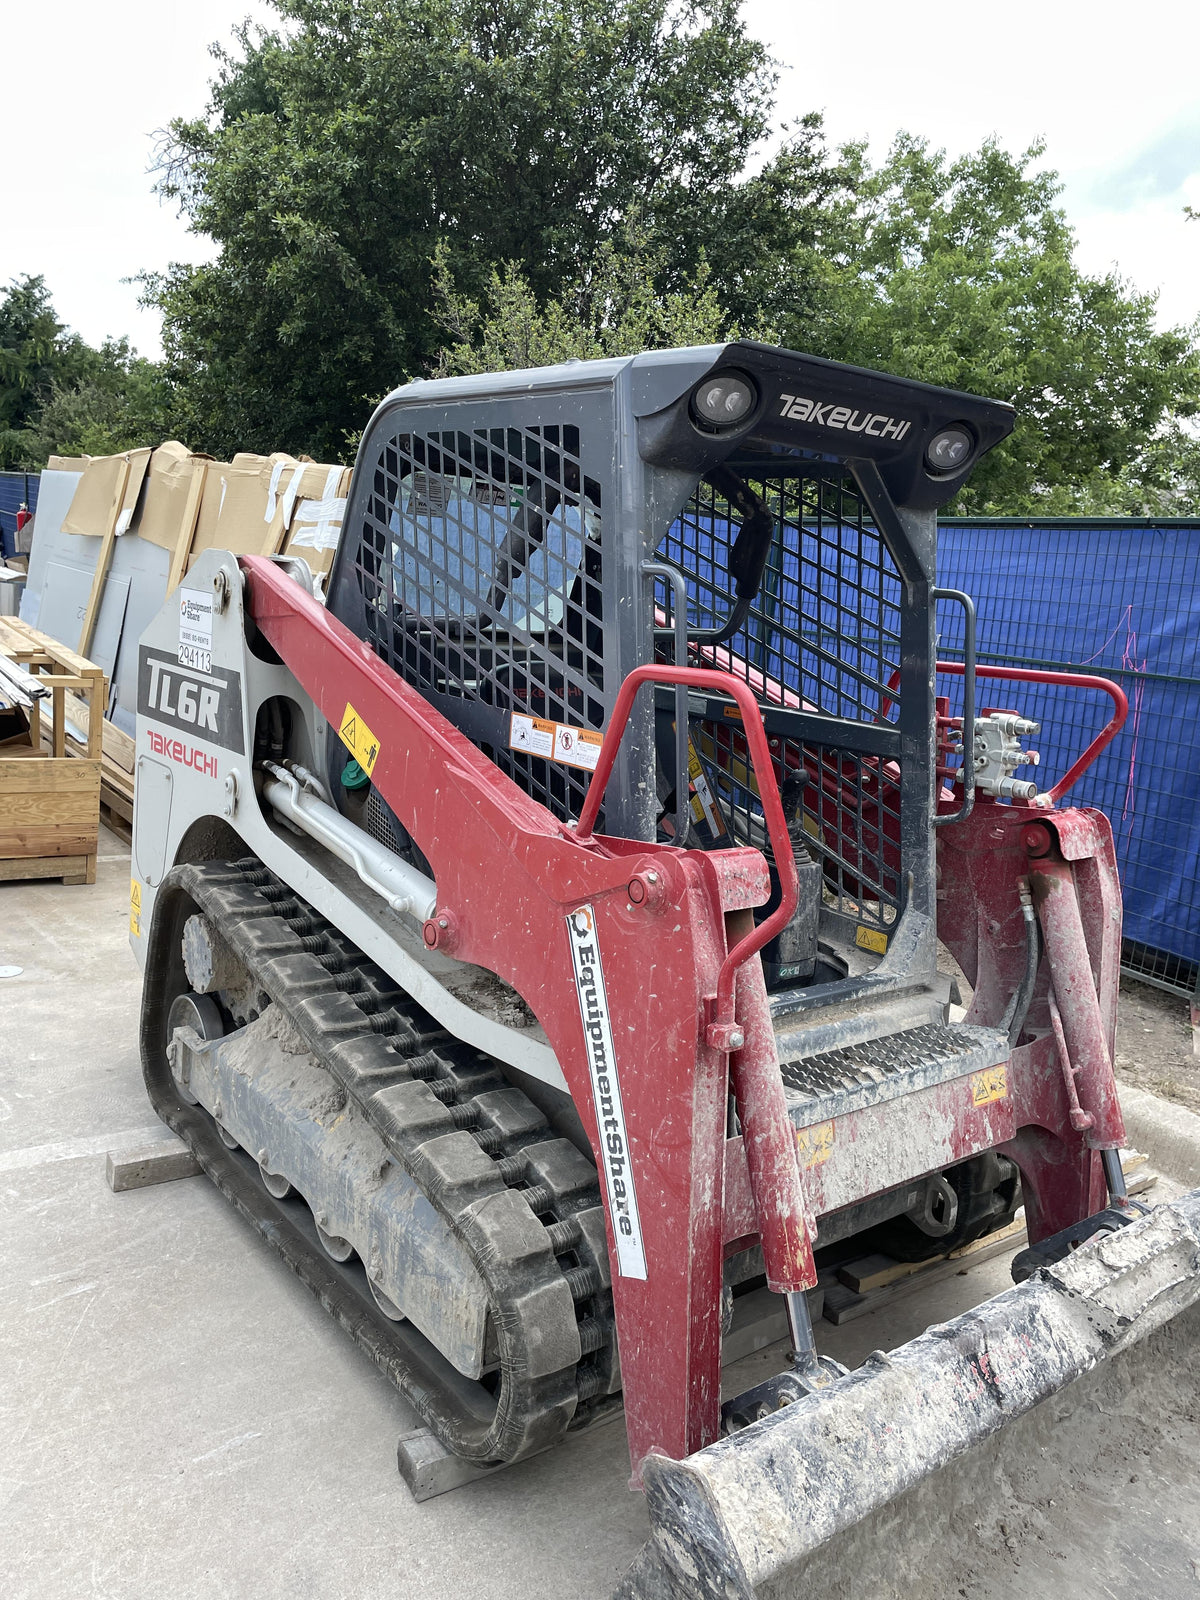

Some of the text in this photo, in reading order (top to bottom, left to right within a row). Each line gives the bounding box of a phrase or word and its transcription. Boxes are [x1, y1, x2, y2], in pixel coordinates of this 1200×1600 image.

[780, 393, 912, 440] TAKEUCHI
[187, 600, 212, 613] Equipment
[187, 611, 200, 622] Share
[179, 645, 211, 672] 294113
[147, 658, 228, 733] TL6R
[147, 730, 218, 779] TAKEUCHI
[578, 944, 633, 1236] EquipmentShare
